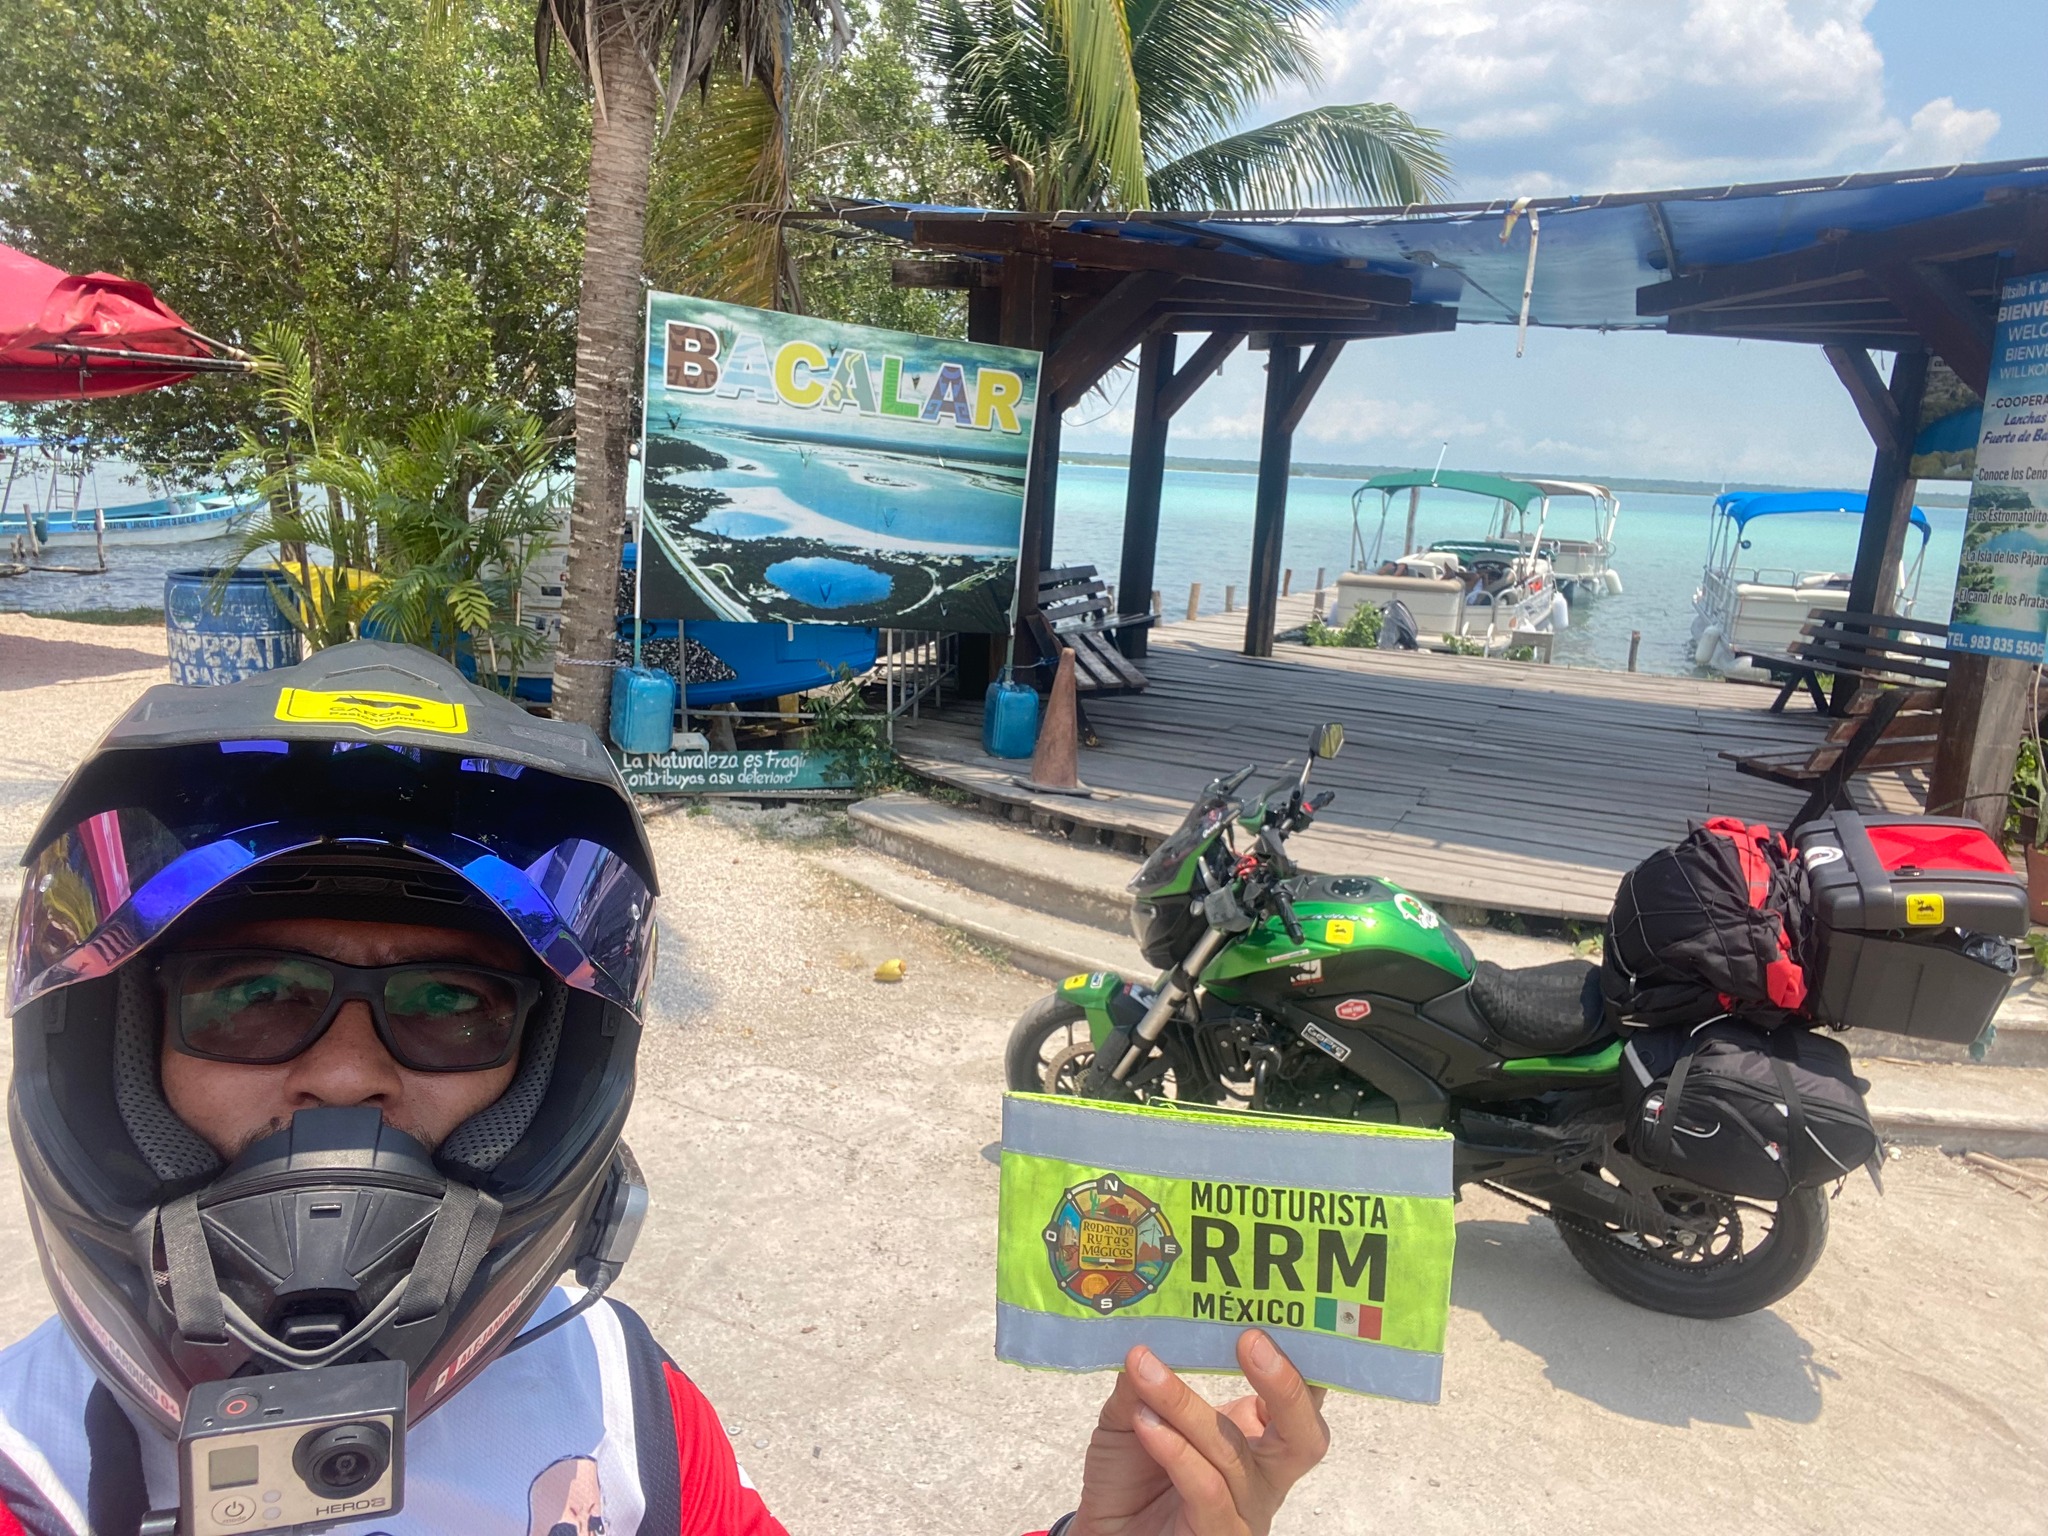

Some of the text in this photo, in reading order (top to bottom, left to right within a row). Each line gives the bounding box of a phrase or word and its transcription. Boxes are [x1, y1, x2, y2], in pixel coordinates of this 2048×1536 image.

[665, 320, 1023, 434] BACALAR
[1983, 431, 2016, 444] Fuerte
[2017, 430, 2031, 442] de
[2011, 467, 2024, 480] los
[1978, 550, 1992, 563] Isla
[1994, 551, 2005, 563] de
[2006, 551, 2019, 564] los
[1969, 589, 1991, 603] canal
[1993, 591, 2003, 604] de
[2005, 592, 2017, 605] los
[1948, 632, 2045, 657] TEL. 983 835 5505
[623, 752, 643, 769] La
[648, 751, 739, 769] Naturaleza
[743, 754, 763, 768] es
[1104, 1180, 1118, 1191] N
[1191, 1181, 1389, 1229] MOTOTURISTA
[1164, 1244, 1176, 1254] E
[1191, 1215, 1388, 1302] RRM
[1101, 1298, 1112, 1309] S
[1193, 1291, 1304, 1327] MÉXICO
[316, 1497, 386, 1516] HERO3
